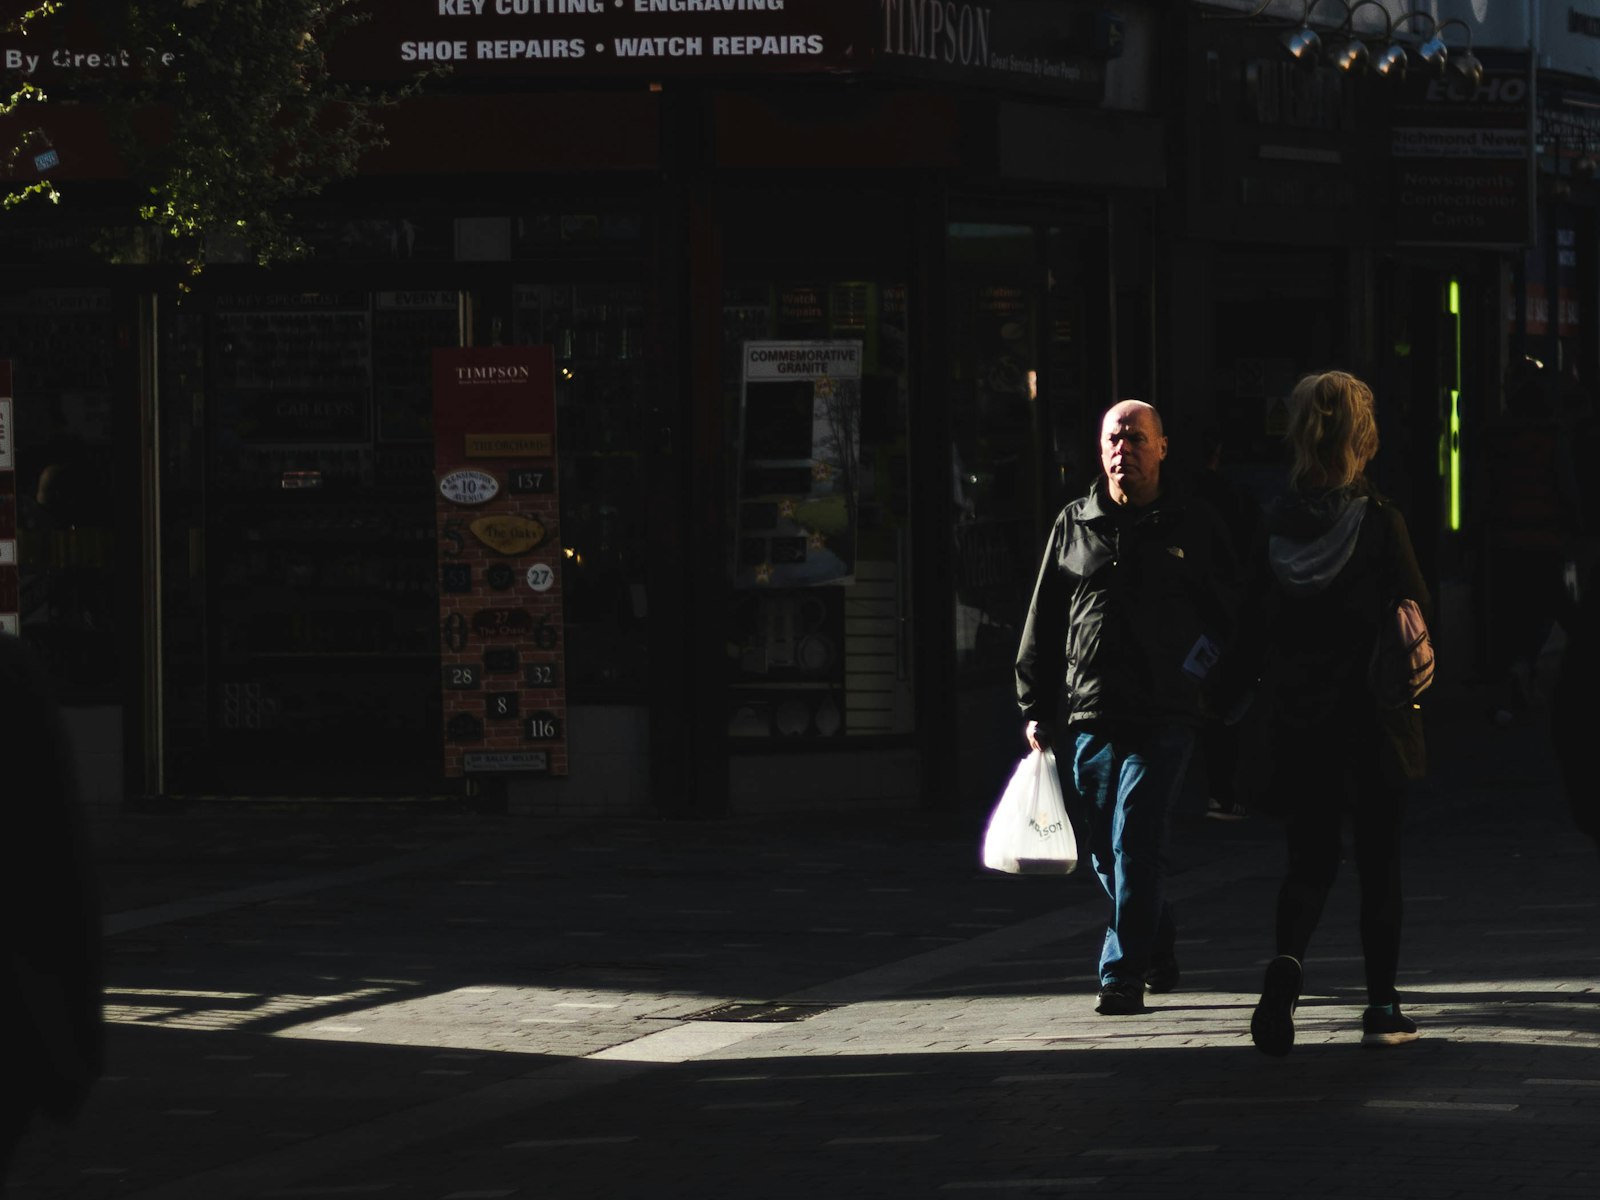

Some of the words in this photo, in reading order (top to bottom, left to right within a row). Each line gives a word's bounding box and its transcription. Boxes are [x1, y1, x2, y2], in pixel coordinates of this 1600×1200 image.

[400, 41, 468, 60] SHOE
[476, 39, 587, 59] REPAIRS
[613, 36, 704, 57] WATCH
[712, 34, 825, 55] REPAIRS
[5, 49, 40, 73] By
[751, 349, 856, 363] COMMEMORATIVE
[455, 365, 529, 379] TIMPSON
[777, 362, 829, 374] GRANITE
[462, 480, 476, 495] 10
[518, 473, 543, 489] 137
[444, 518, 464, 558] 5
[532, 570, 549, 584] 27
[495, 611, 509, 624] 27
[534, 613, 557, 649] 6
[452, 668, 473, 684] 28
[533, 666, 552, 684] 32
[497, 696, 507, 714] 8
[531, 719, 555, 737] 116
